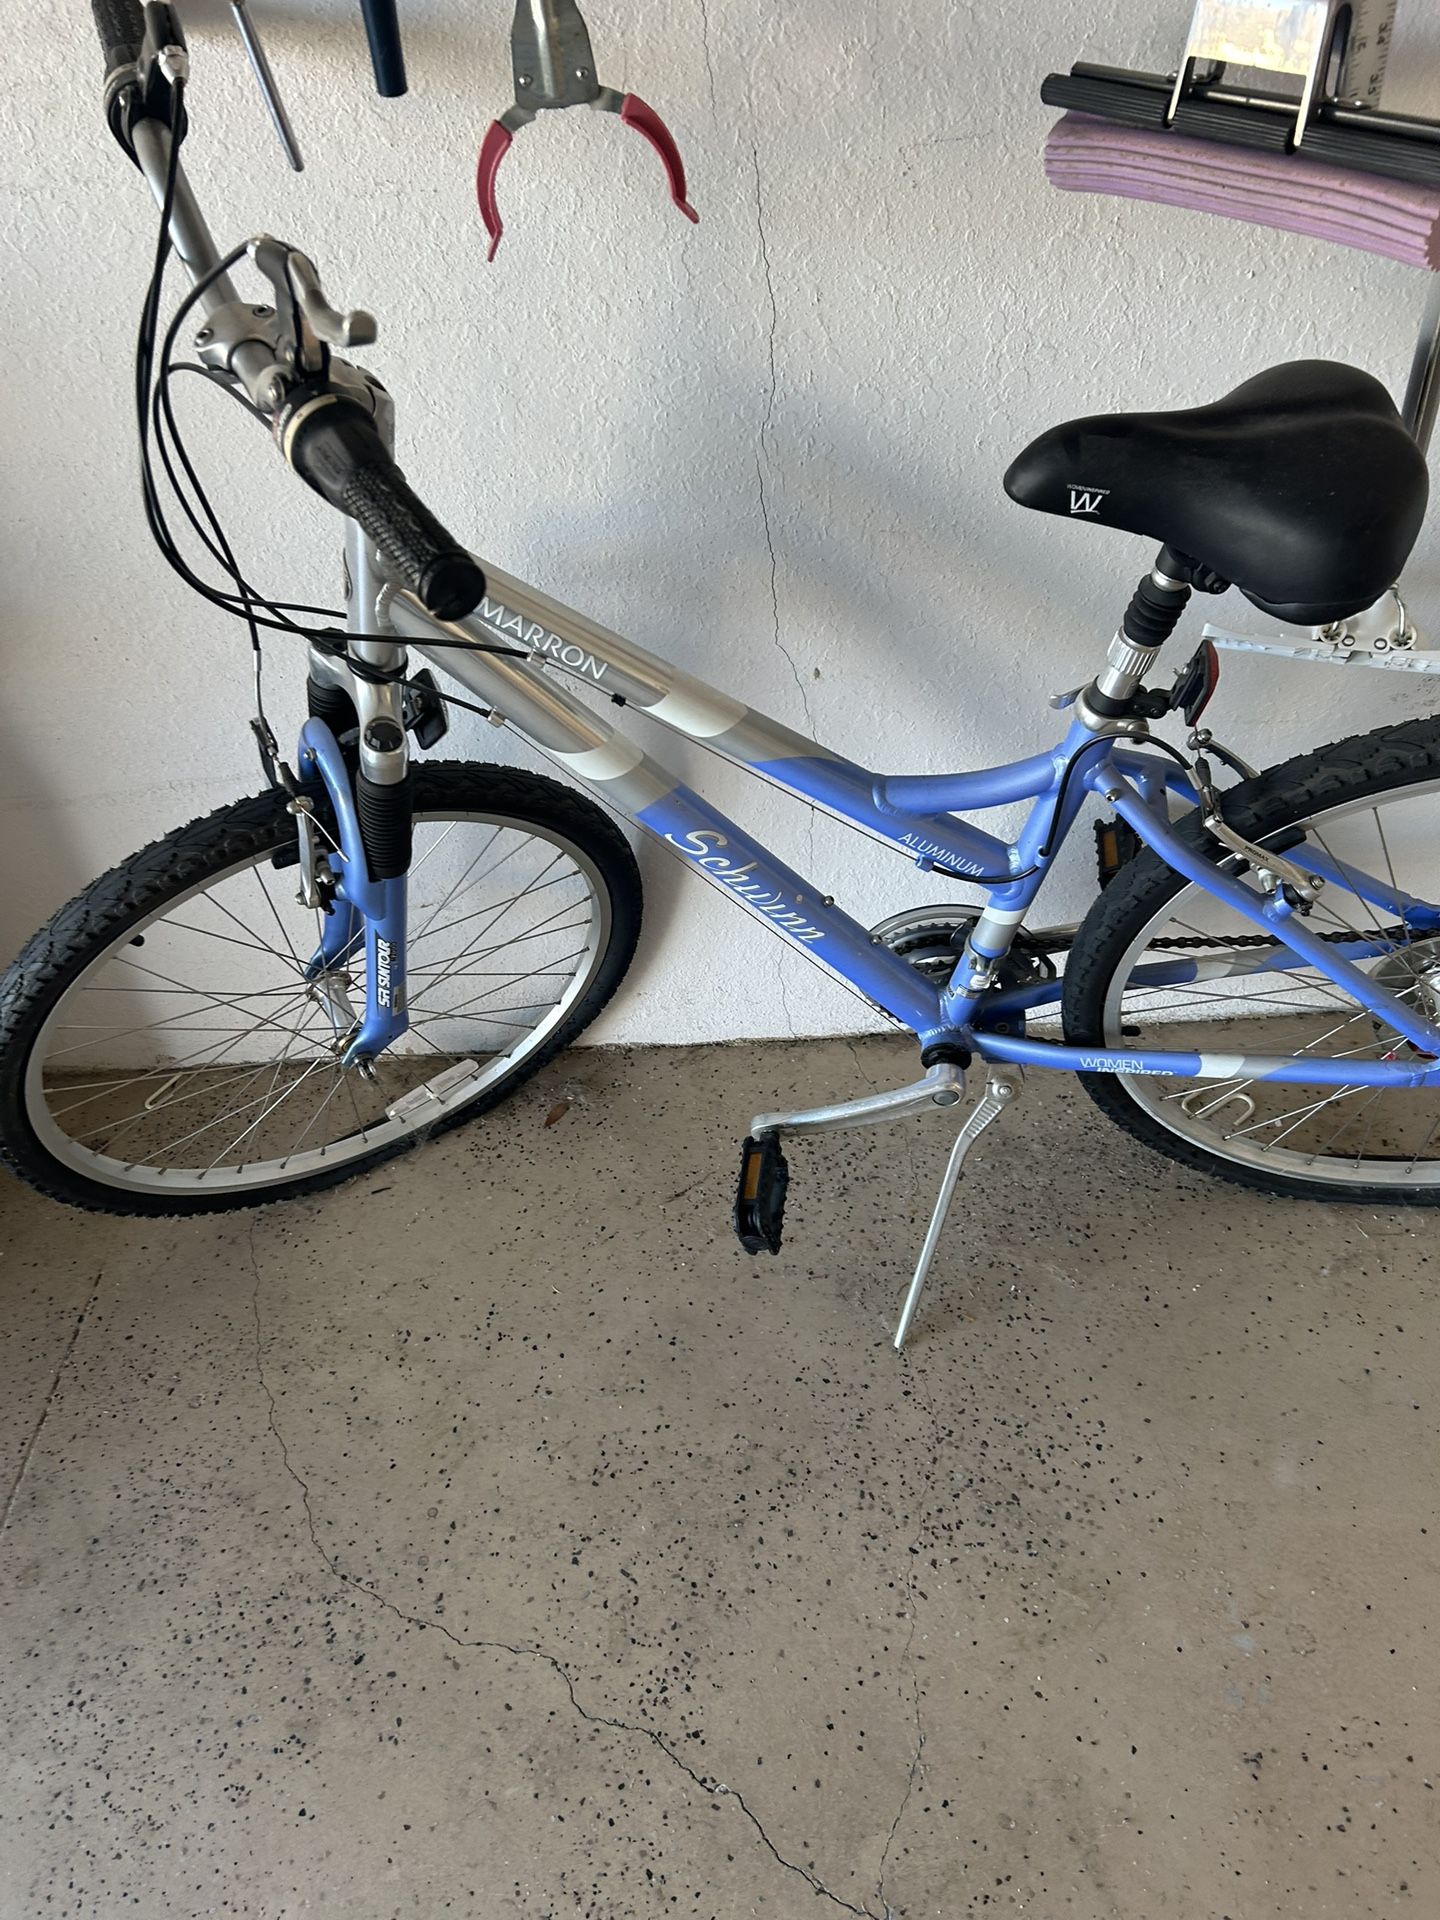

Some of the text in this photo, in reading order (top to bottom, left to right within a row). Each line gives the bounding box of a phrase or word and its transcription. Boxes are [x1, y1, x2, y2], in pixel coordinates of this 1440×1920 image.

[897, 832, 985, 877] ALUMINUM
[664, 830, 825, 944] Schwinn
[377, 938, 391, 1008] SR SUNTOUR
[1080, 1057, 1143, 1070] WOMEN
